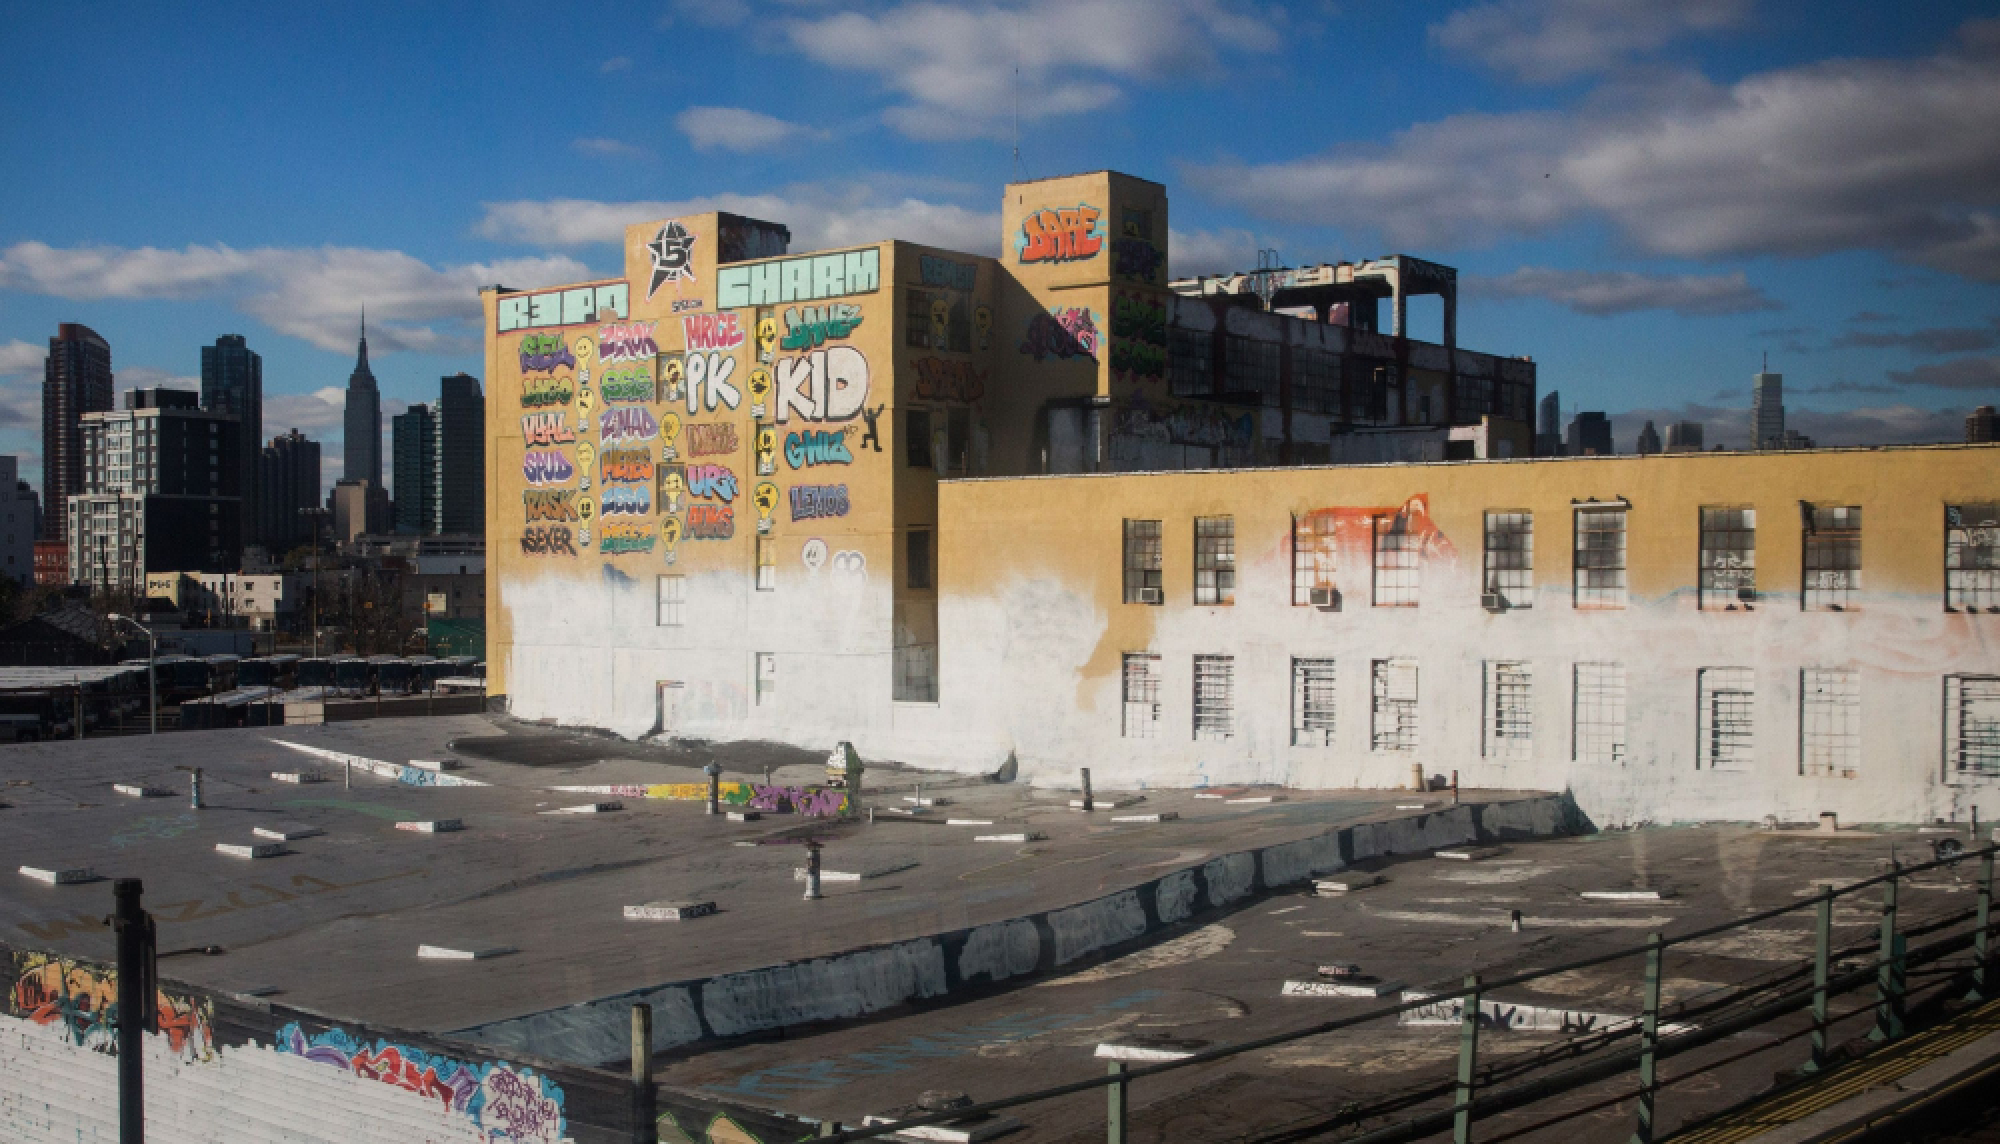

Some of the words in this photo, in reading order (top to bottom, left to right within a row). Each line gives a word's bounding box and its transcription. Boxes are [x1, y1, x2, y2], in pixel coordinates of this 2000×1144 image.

[717, 248, 880, 310] CHARM
[686, 352, 742, 415] PK
[775, 346, 869, 424] KID
